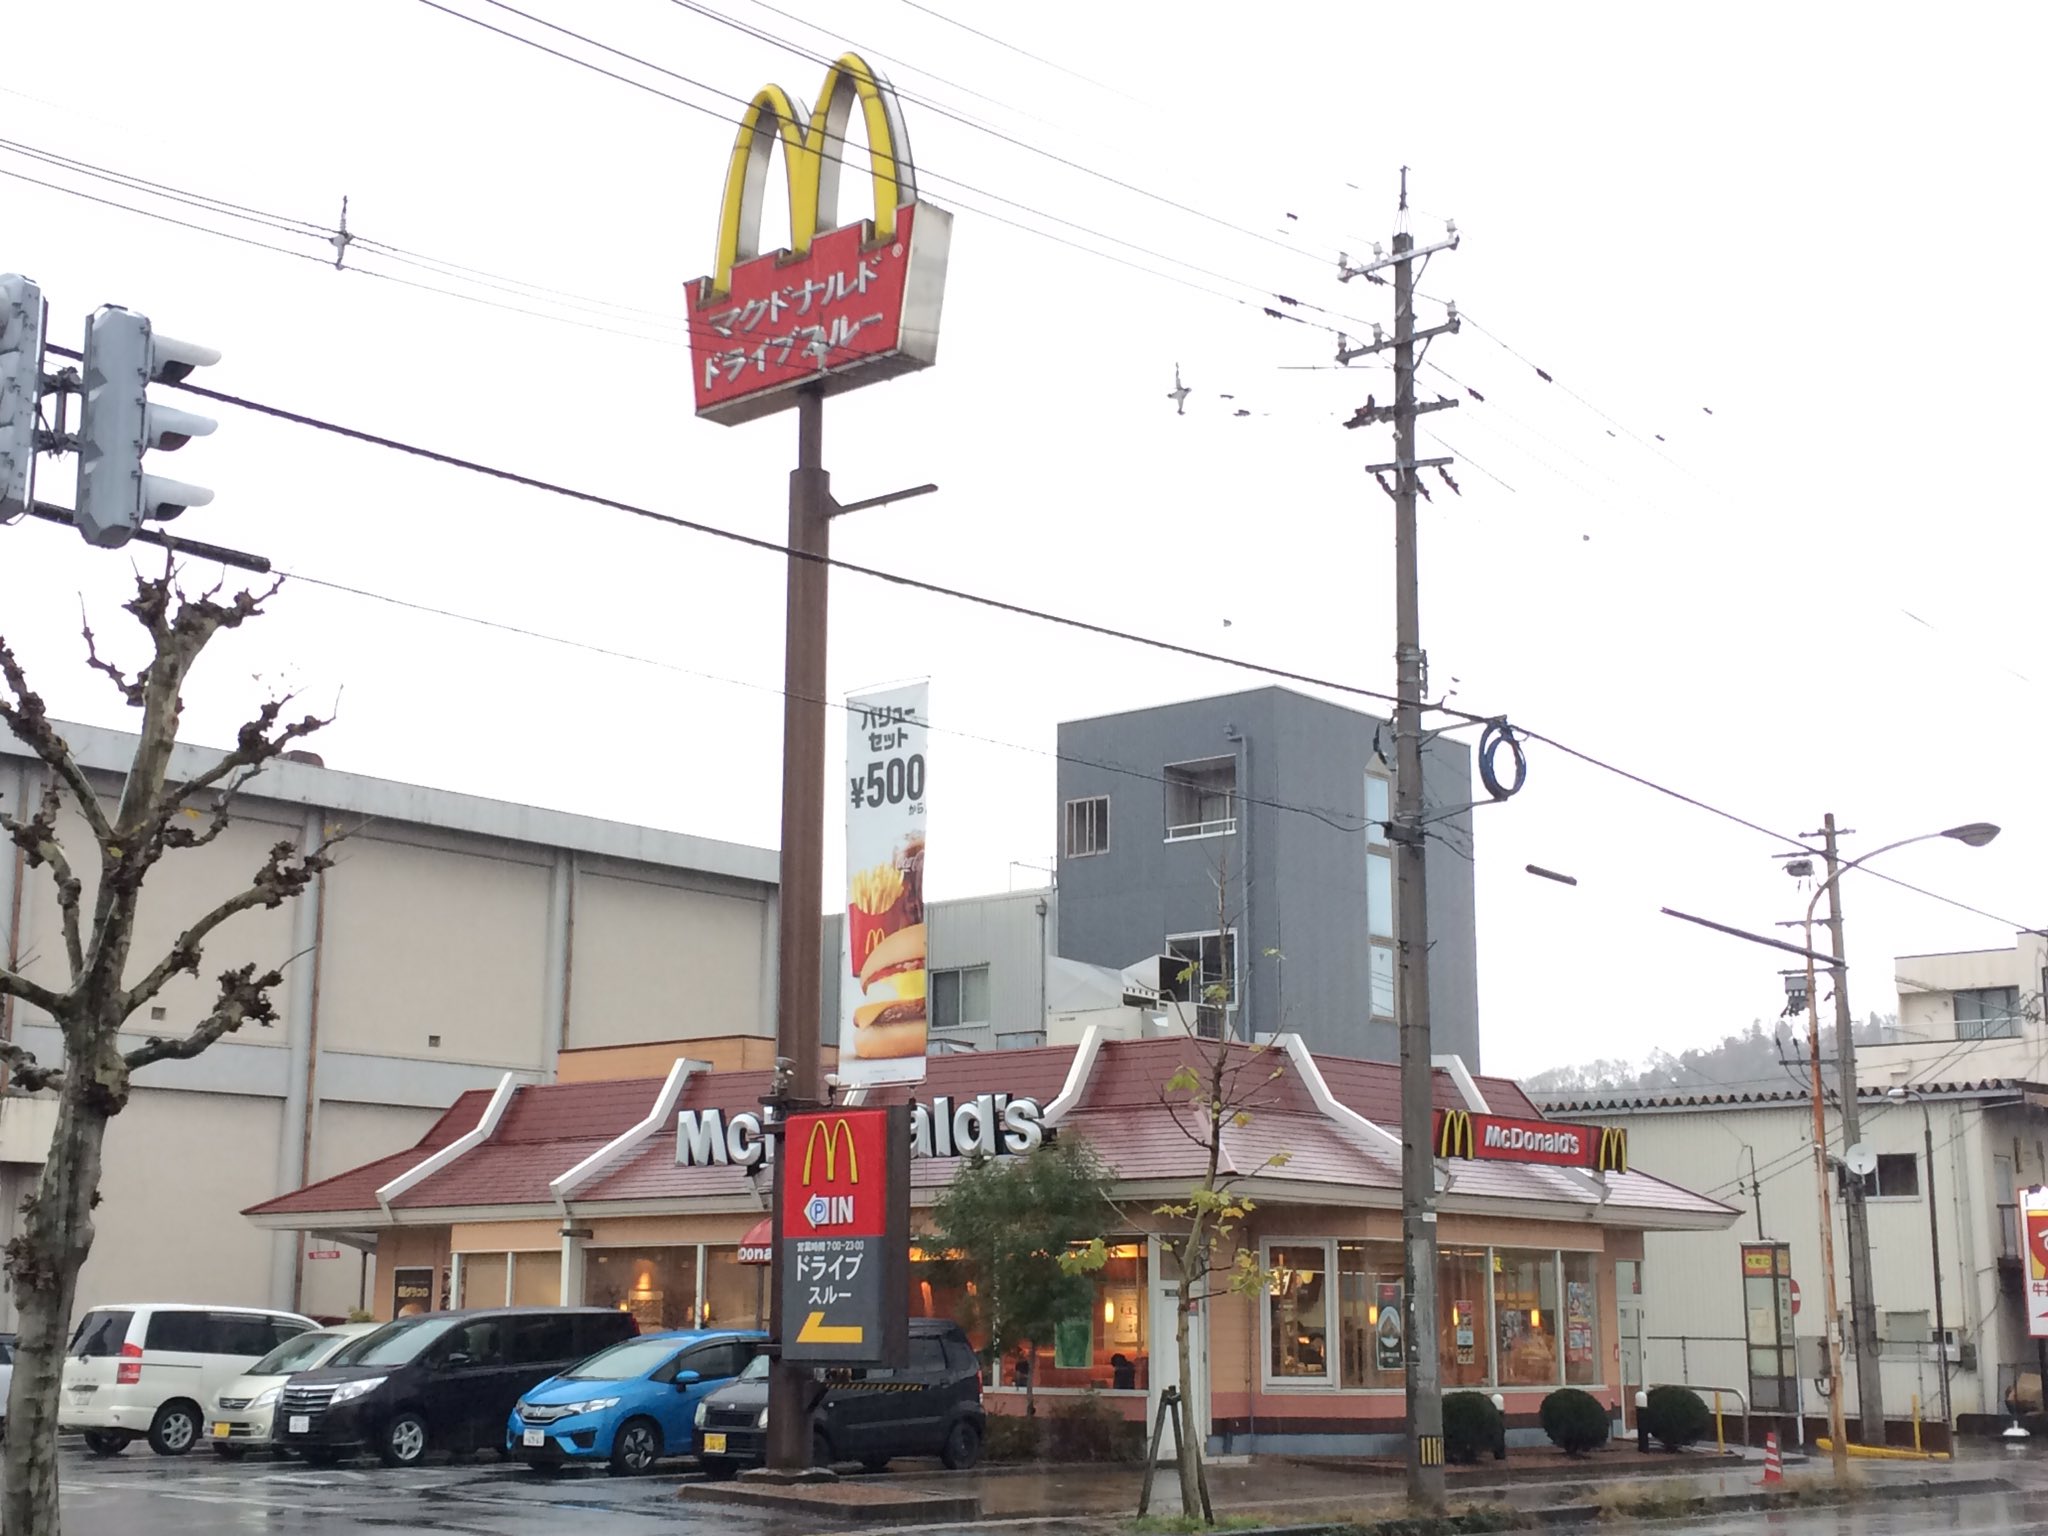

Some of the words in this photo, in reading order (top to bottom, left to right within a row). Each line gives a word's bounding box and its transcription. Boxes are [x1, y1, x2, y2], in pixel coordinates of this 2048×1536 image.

[709, 256, 882, 336] マクドナルド
[868, 726, 909, 753] セット
[850, 753, 925, 809] ¥500
[1484, 1124, 1580, 1155] McDonald's
[831, 1195, 854, 1224] IN
[797, 1252, 864, 1281] ドライブ
[808, 1285, 852, 1305] スルー
